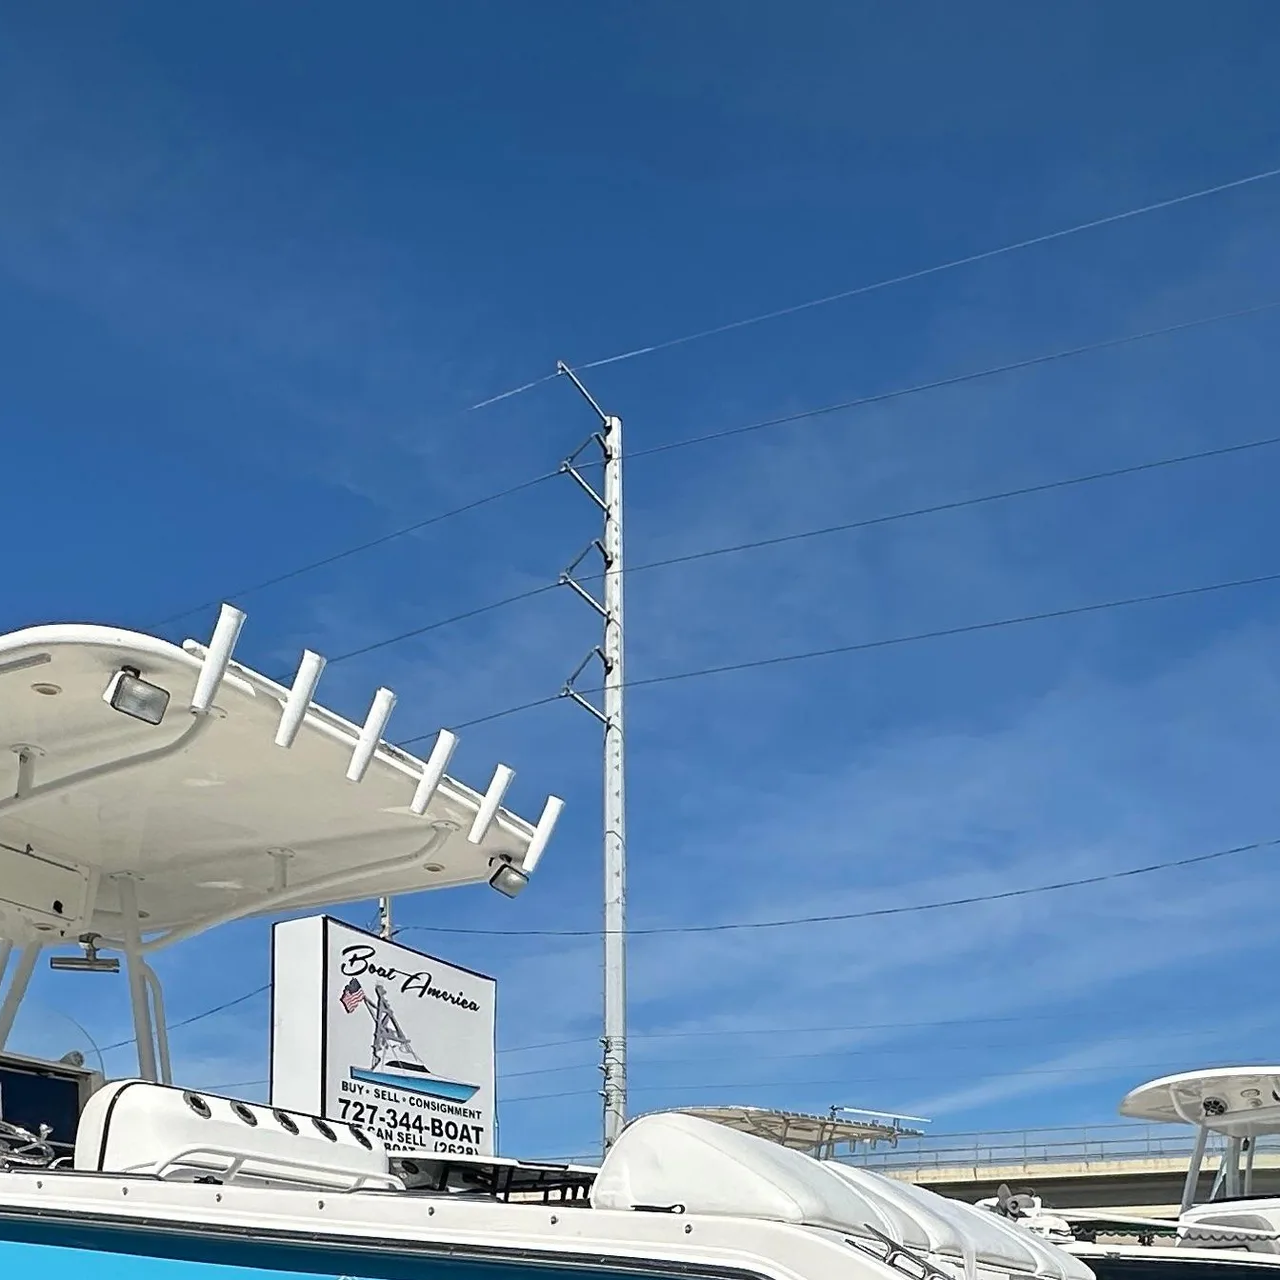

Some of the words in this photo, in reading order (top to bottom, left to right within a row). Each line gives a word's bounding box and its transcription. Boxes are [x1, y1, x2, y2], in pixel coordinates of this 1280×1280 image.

[340, 945, 397, 980] Boat
[401, 971, 480, 1012] America
[337, 1097, 484, 1145] 727-344-BOAT
[341, 1080, 365, 1095] BUY
[373, 1088, 400, 1103] SELL
[409, 1096, 483, 1120] CONSIGNMENT
[397, 1131, 427, 1147] SELL
